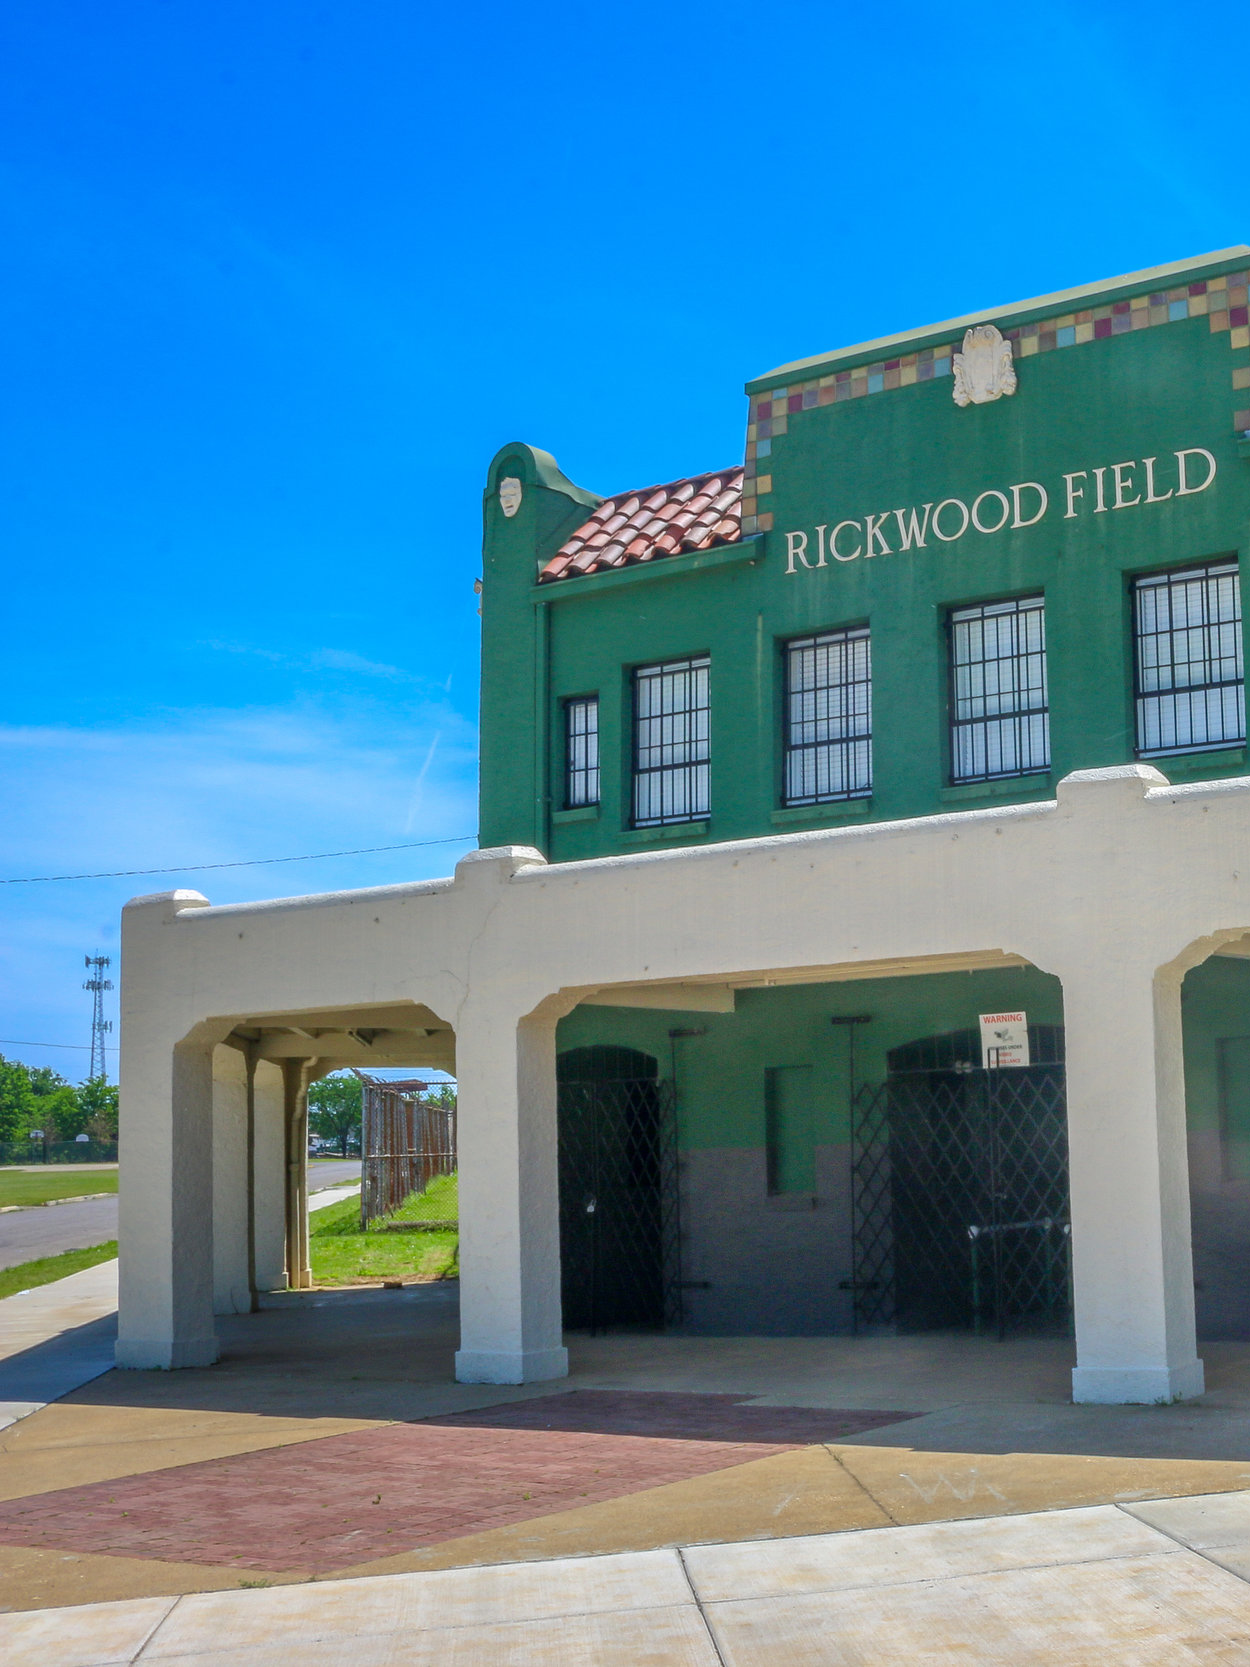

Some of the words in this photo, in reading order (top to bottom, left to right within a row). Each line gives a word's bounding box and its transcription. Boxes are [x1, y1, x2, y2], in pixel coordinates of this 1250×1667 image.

[785, 481, 1048, 574] RICKWOOD
[1063, 448, 1217, 518] FIELD
[983, 1014, 1022, 1024] WARNING
